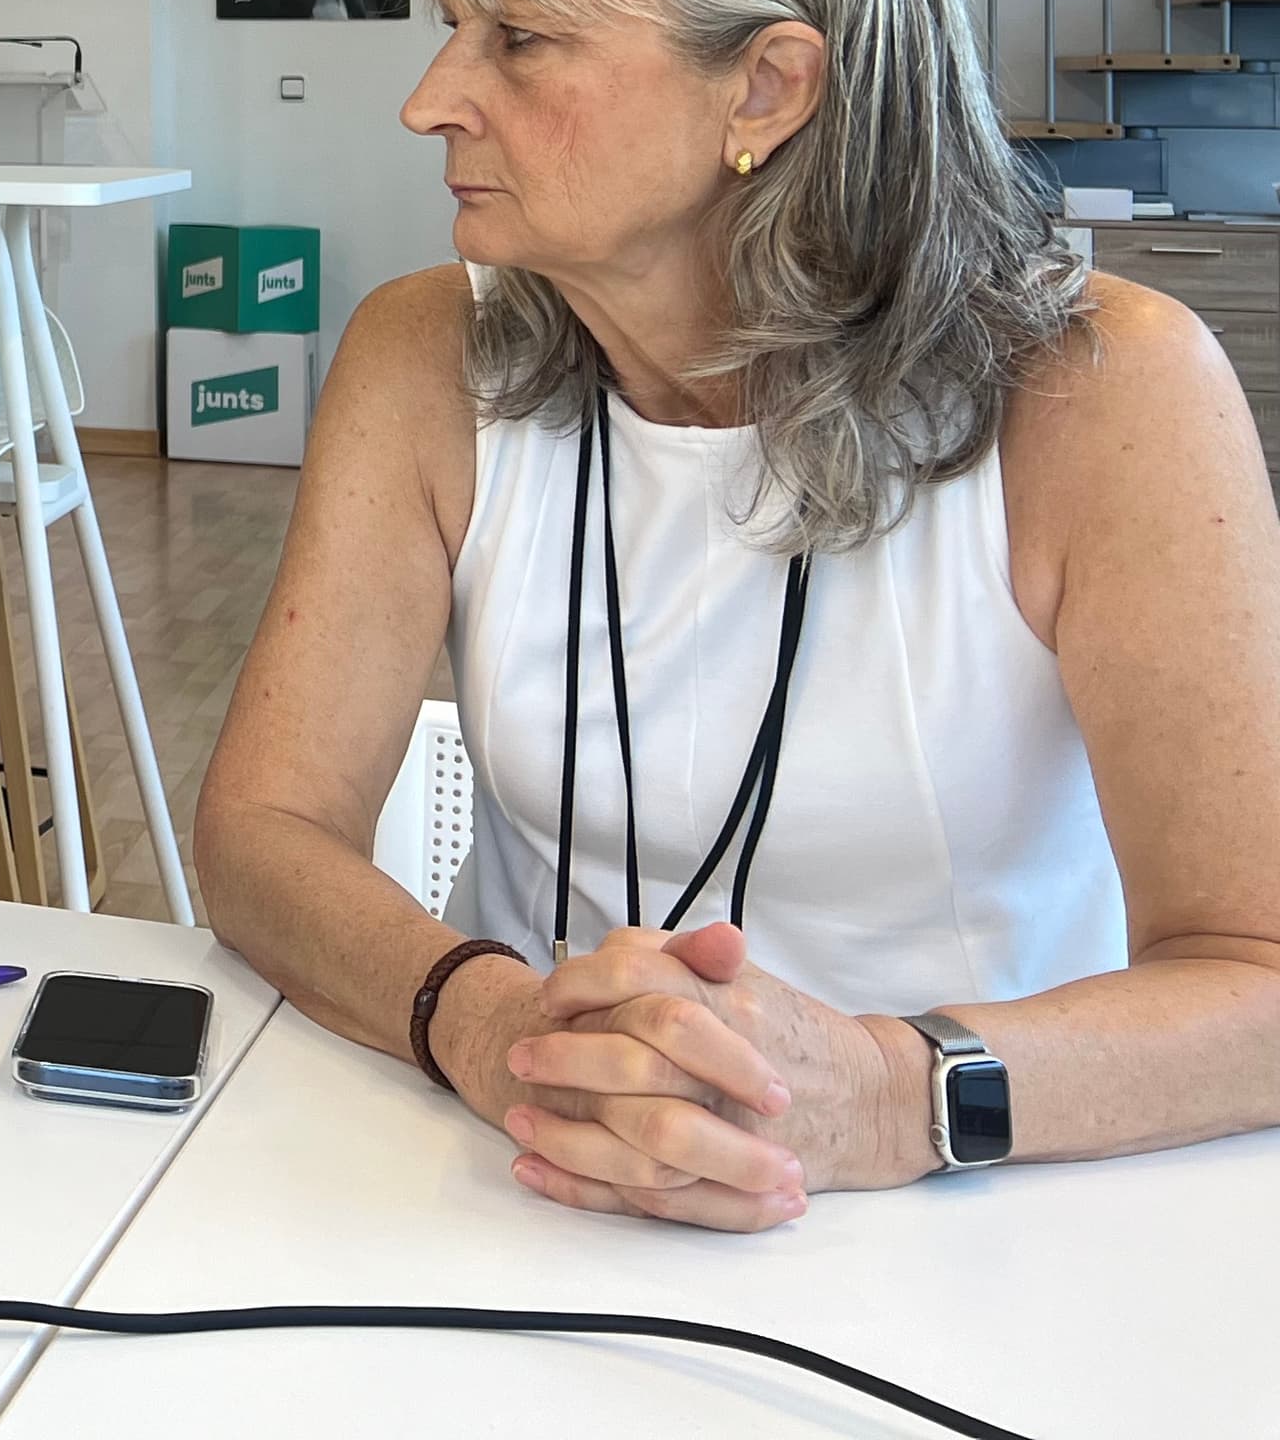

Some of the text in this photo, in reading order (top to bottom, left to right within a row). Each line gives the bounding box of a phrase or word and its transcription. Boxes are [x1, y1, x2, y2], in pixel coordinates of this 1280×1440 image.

[184, 271, 216, 288] junts
[261, 273, 296, 293] junts
[196, 385, 265, 413] junts
